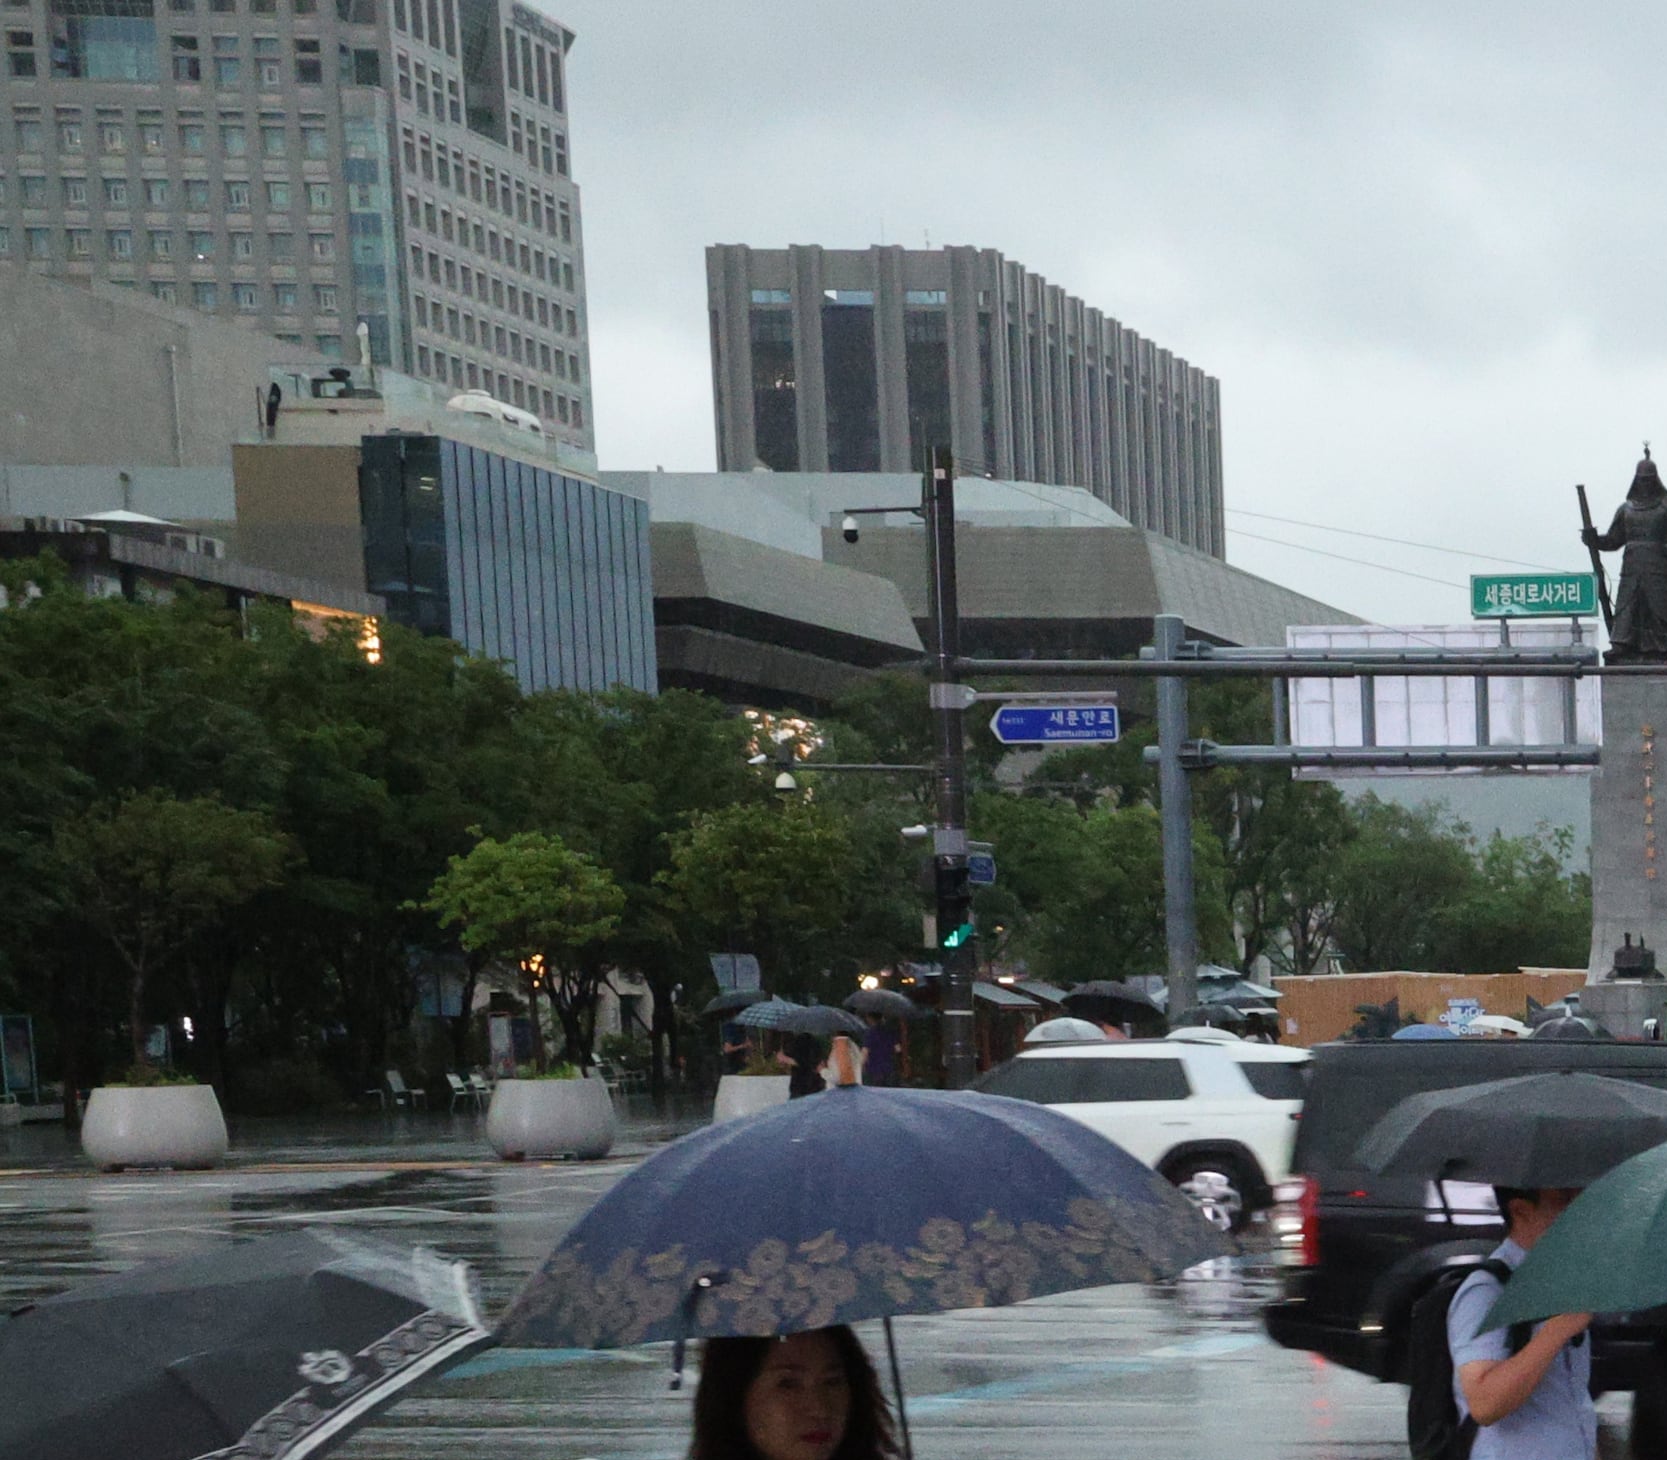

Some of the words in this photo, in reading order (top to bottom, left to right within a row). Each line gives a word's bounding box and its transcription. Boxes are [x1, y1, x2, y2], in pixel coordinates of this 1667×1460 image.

[1484, 582, 1580, 606] 세종대로사거리
[1050, 710, 1112, 726] 새문안로
[1044, 728, 1113, 738] Saemunan-ro
